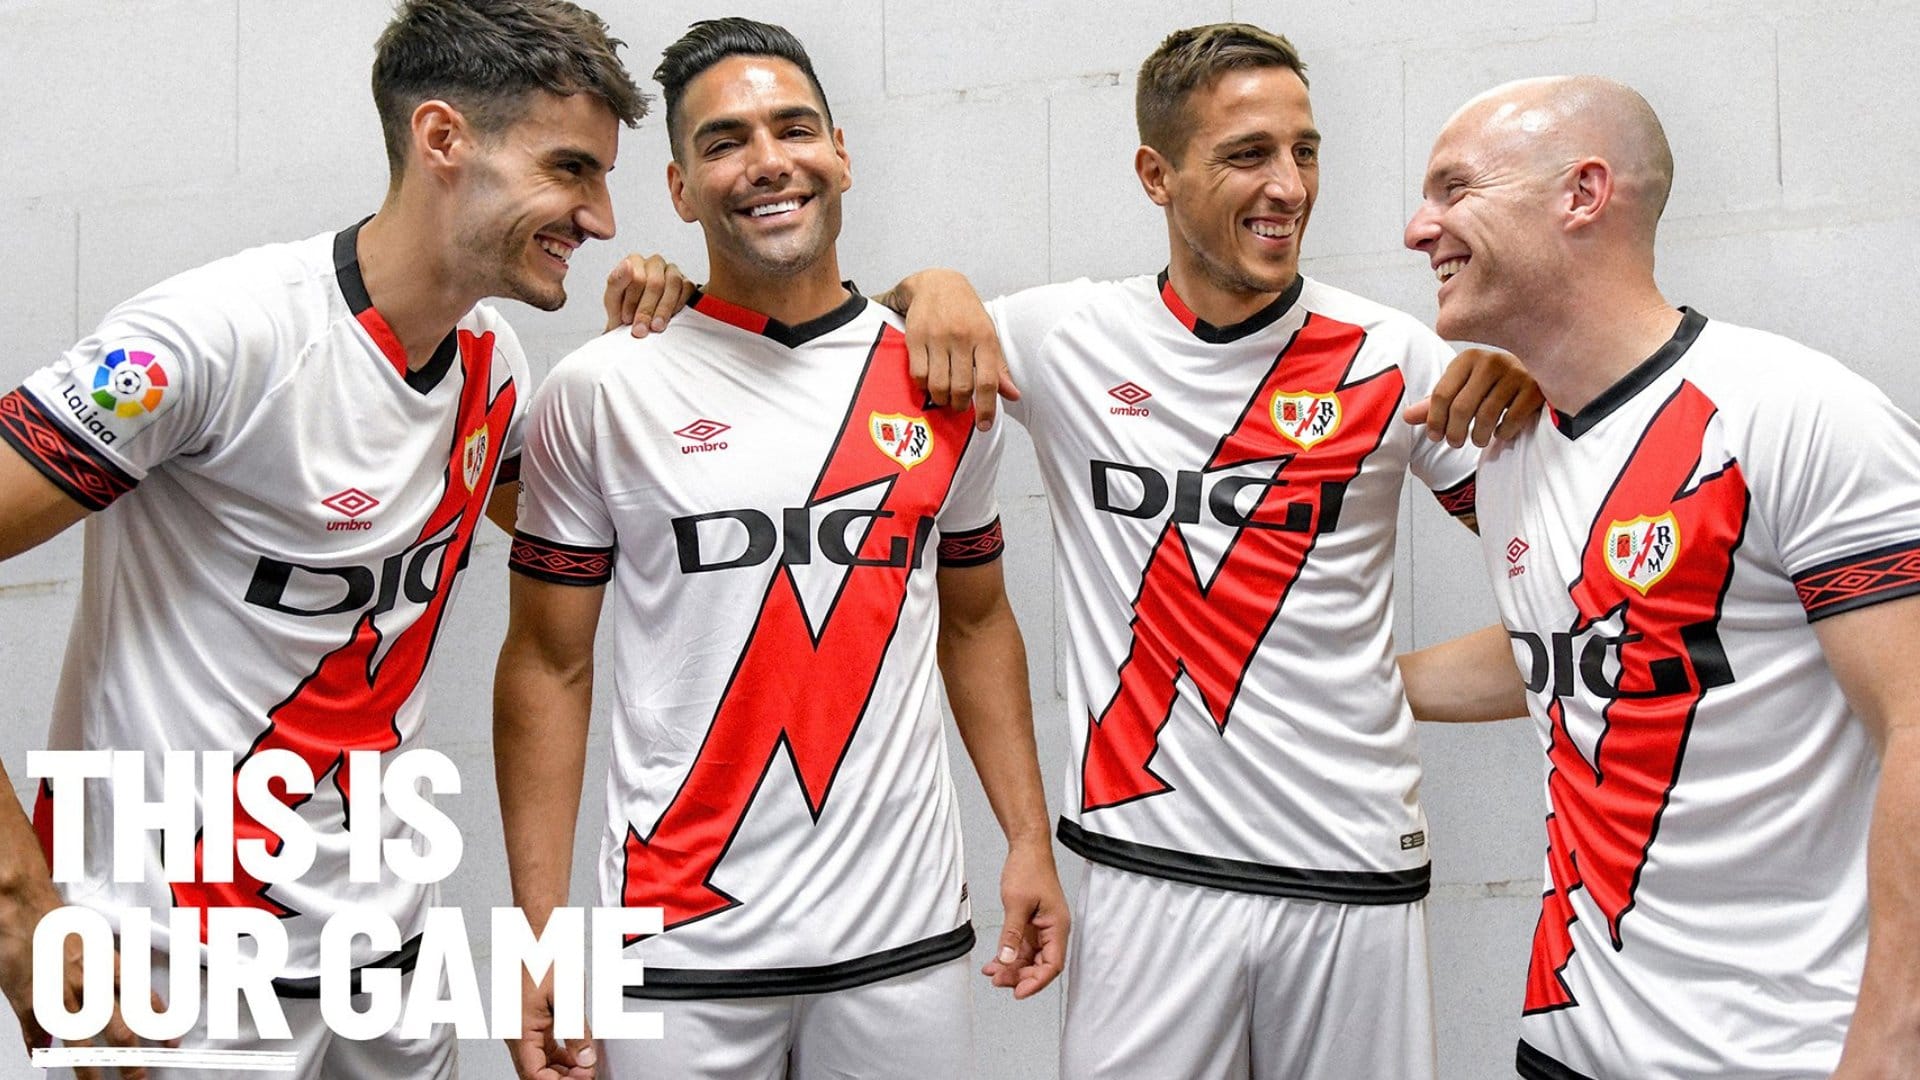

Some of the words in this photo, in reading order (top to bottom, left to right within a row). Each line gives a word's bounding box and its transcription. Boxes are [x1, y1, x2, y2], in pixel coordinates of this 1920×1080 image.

[63, 384, 117, 445] LaLiga
[1111, 406, 1150, 417] umbro
[682, 440, 728, 454] umbro
[1090, 459, 1349, 533] DIGI
[326, 519, 373, 531] umbro
[671, 508, 935, 574] DIGI
